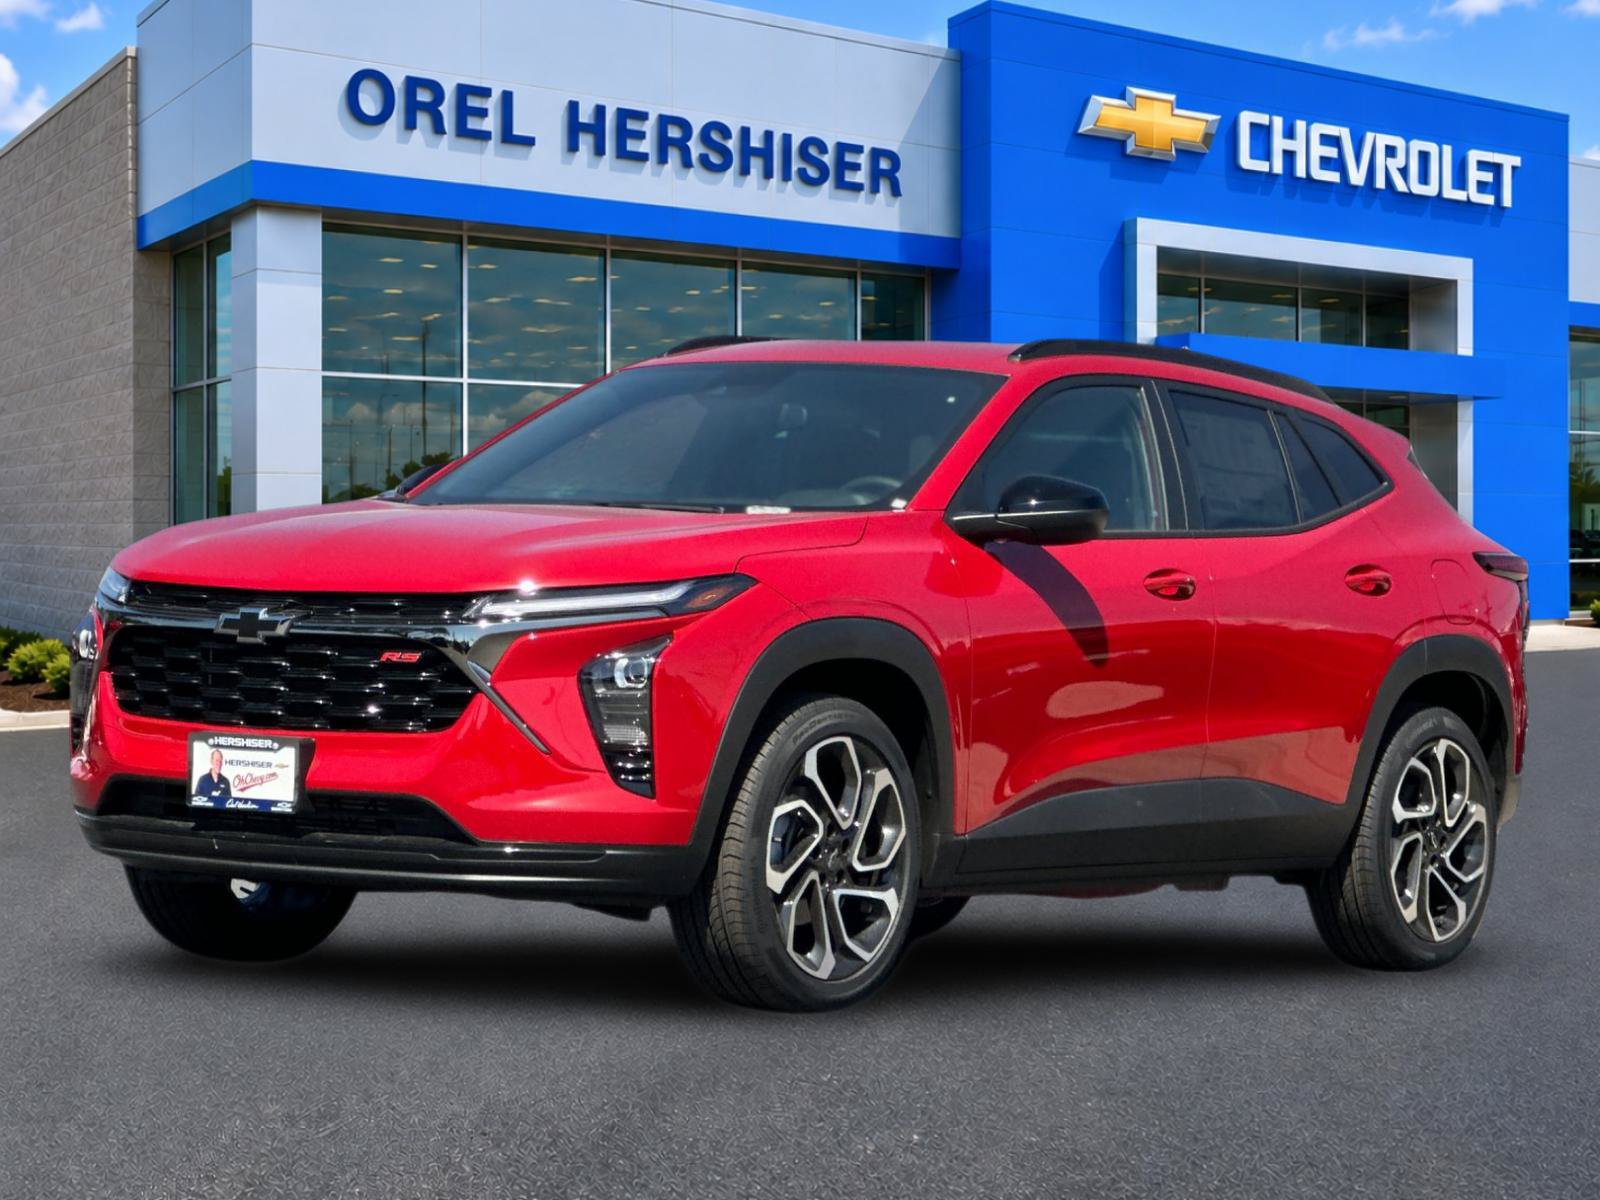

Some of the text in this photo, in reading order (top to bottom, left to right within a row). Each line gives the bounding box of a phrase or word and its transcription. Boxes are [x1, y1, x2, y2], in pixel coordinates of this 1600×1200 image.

[346, 69, 902, 197] OREL HERSHISER
[1238, 110, 1521, 208] CHEVROLET
[380, 651, 421, 663] RS
[214, 736, 273, 748] HERSHISER
[225, 759, 273, 768] HERSHISER
